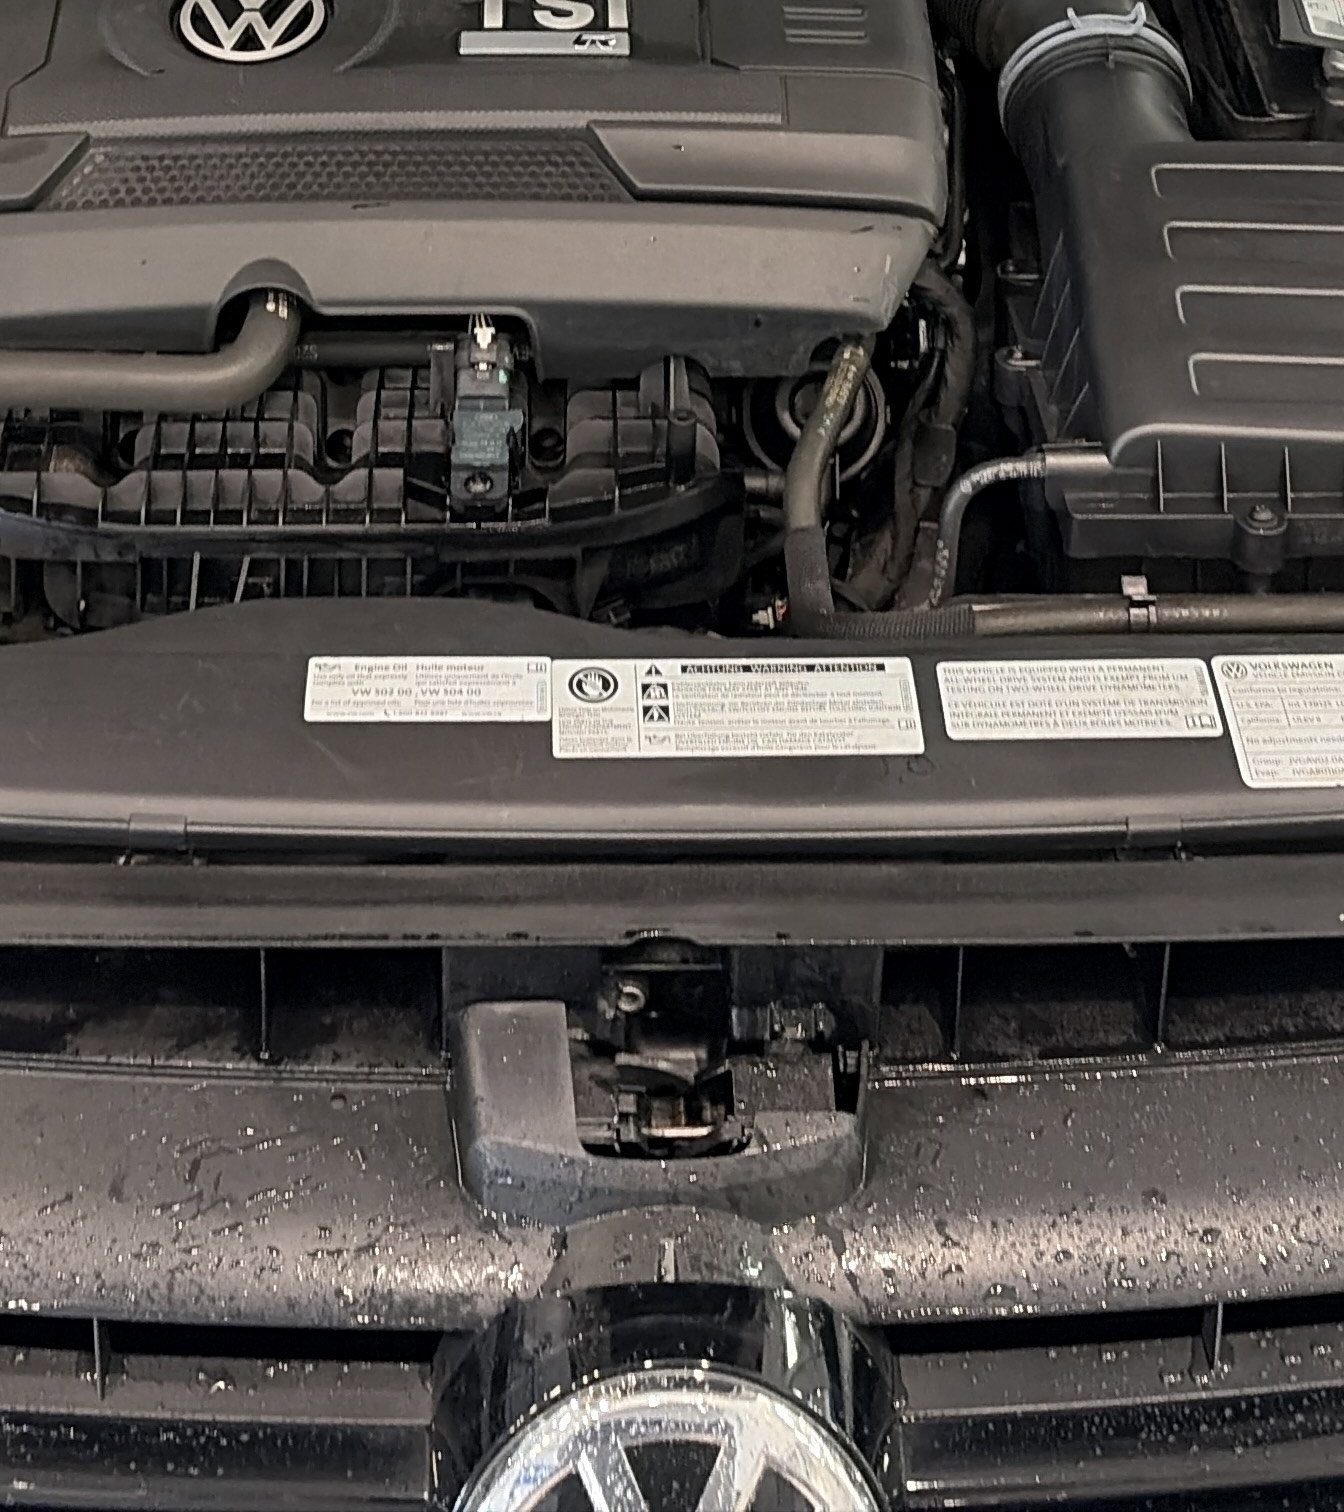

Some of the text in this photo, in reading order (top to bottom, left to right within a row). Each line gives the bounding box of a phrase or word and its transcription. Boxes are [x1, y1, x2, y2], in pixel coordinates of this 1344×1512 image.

[355, 663, 407, 673] Engine Oil
[687, 663, 876, 673] ACHTUNG WARNING ATTENTION
[1248, 661, 1334, 670] VOLKSWAGEN
[943, 667, 964, 675] THIS
[967, 667, 1005, 675] VEHICLE
[1019, 666, 1066, 674] EQUIPPED
[1107, 665, 1164, 673] PERMANENT
[1292, 671, 1335, 679] EMISSION
[352, 688, 371, 696] VW
[421, 688, 440, 696] VW
[1100, 684, 1180, 692] DYNAMOMETERS
[1138, 698, 1208, 706] TRANSMISSION
[1246, 736, 1260, 744] No
[1262, 735, 1318, 745] adjustments
